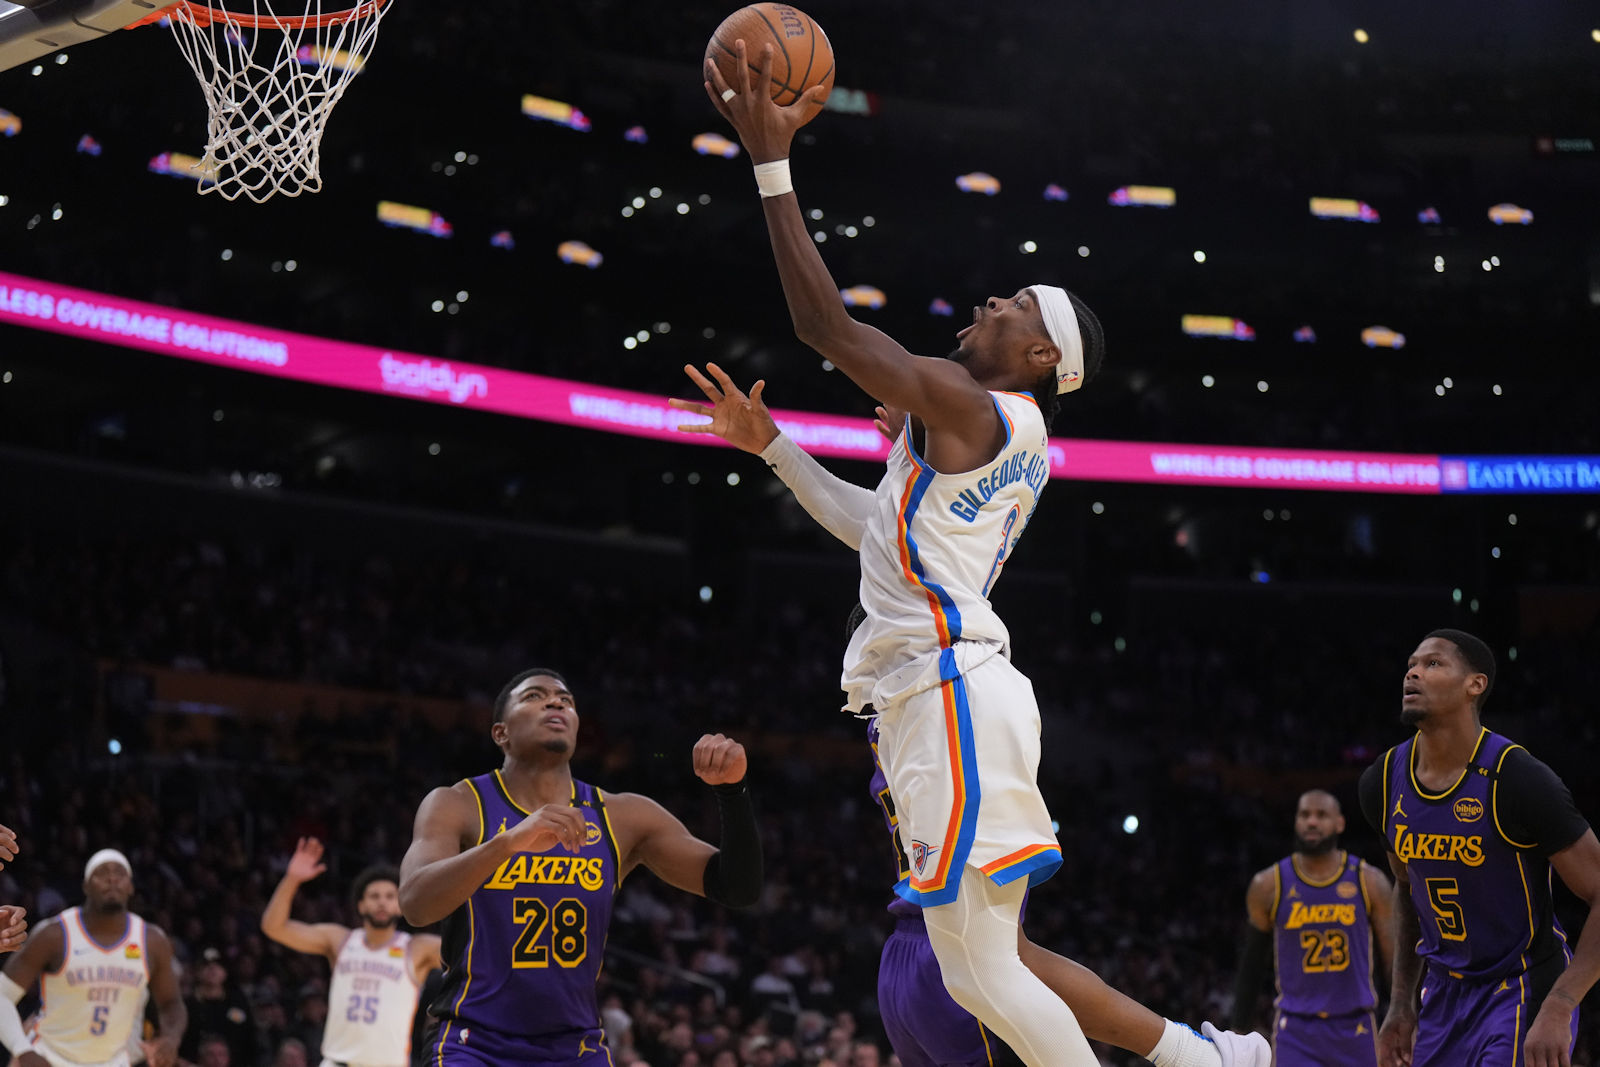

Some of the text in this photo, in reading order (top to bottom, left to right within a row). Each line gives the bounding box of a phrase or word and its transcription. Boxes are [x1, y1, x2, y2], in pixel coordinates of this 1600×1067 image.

[56, 298, 171, 344] COVERAGE
[173, 321, 288, 367] SOLUTIONS
[379, 352, 488, 403] boldyn
[1150, 453, 1252, 478] WIRELESS
[1255, 457, 1354, 483] COVERAGE
[1456, 804, 1481, 815] bibigo
[1395, 824, 1485, 867] LAKERS
[484, 856, 604, 891] LAKERS
[1285, 901, 1356, 930] LAKERS
[1425, 878, 1467, 942] 5
[512, 898, 587, 968] 28
[1301, 930, 1351, 973] 23
[66, 967, 144, 988] OKLAHOMA
[88, 988, 120, 1003] CITY
[346, 995, 379, 1024] 25
[90, 1005, 110, 1037] 5
